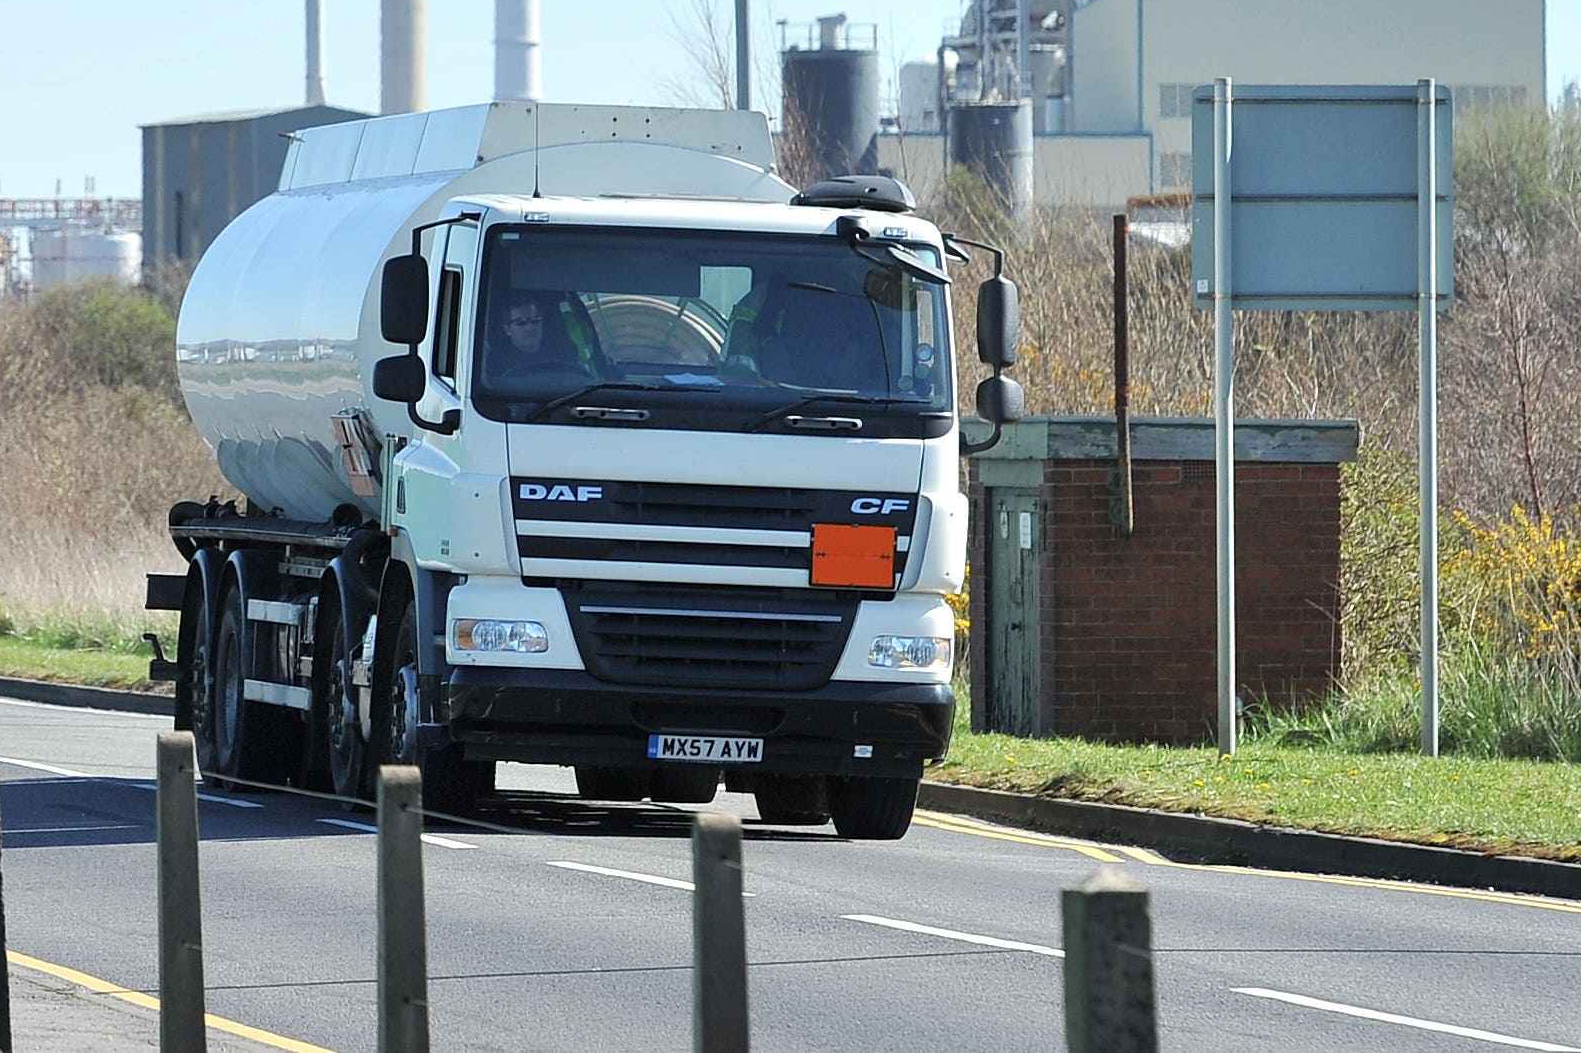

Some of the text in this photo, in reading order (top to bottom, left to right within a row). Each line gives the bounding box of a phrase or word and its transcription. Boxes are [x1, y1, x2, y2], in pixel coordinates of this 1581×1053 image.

[520, 484, 603, 501] DAF
[851, 497, 910, 514] CF
[662, 738, 760, 759] MX57 AYW
